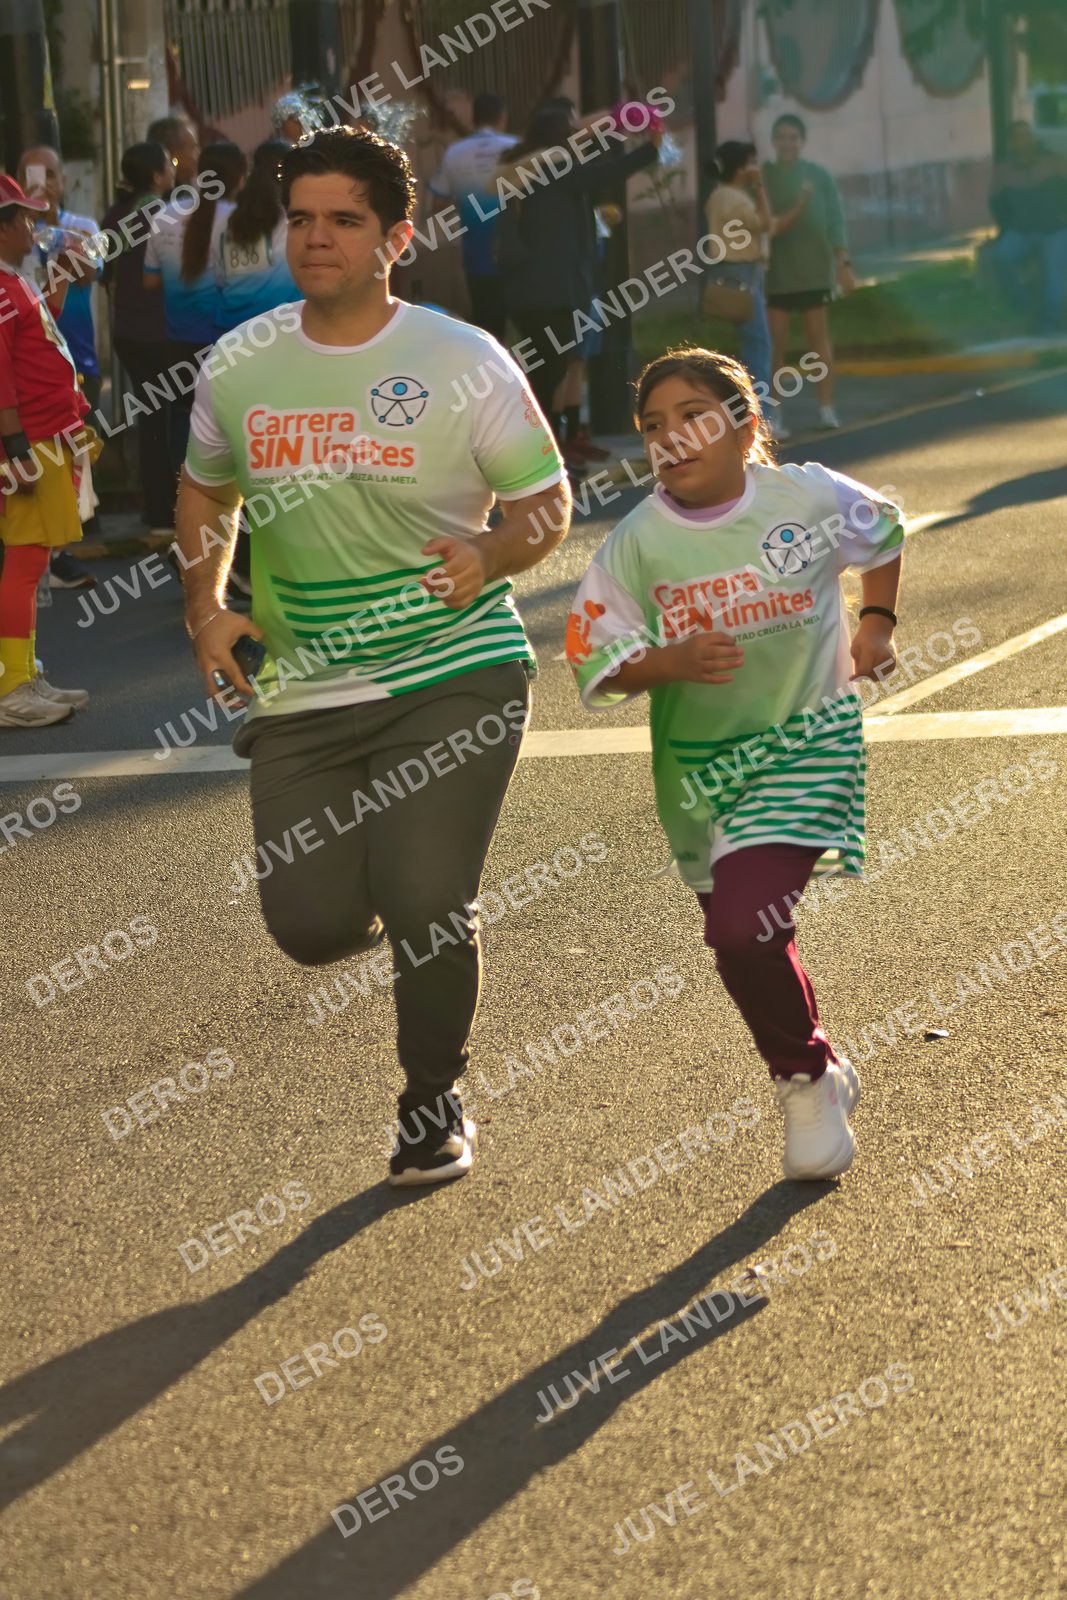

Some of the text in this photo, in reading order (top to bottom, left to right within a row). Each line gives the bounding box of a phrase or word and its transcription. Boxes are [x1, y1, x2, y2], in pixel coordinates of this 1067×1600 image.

[248, 410, 355, 437] Carrera
[250, 435, 304, 470] SIN
[375, 474, 389, 483] LA
[390, 475, 417, 485] META
[655, 572, 758, 610] Carrera
[756, 623, 788, 638] CRUZA
